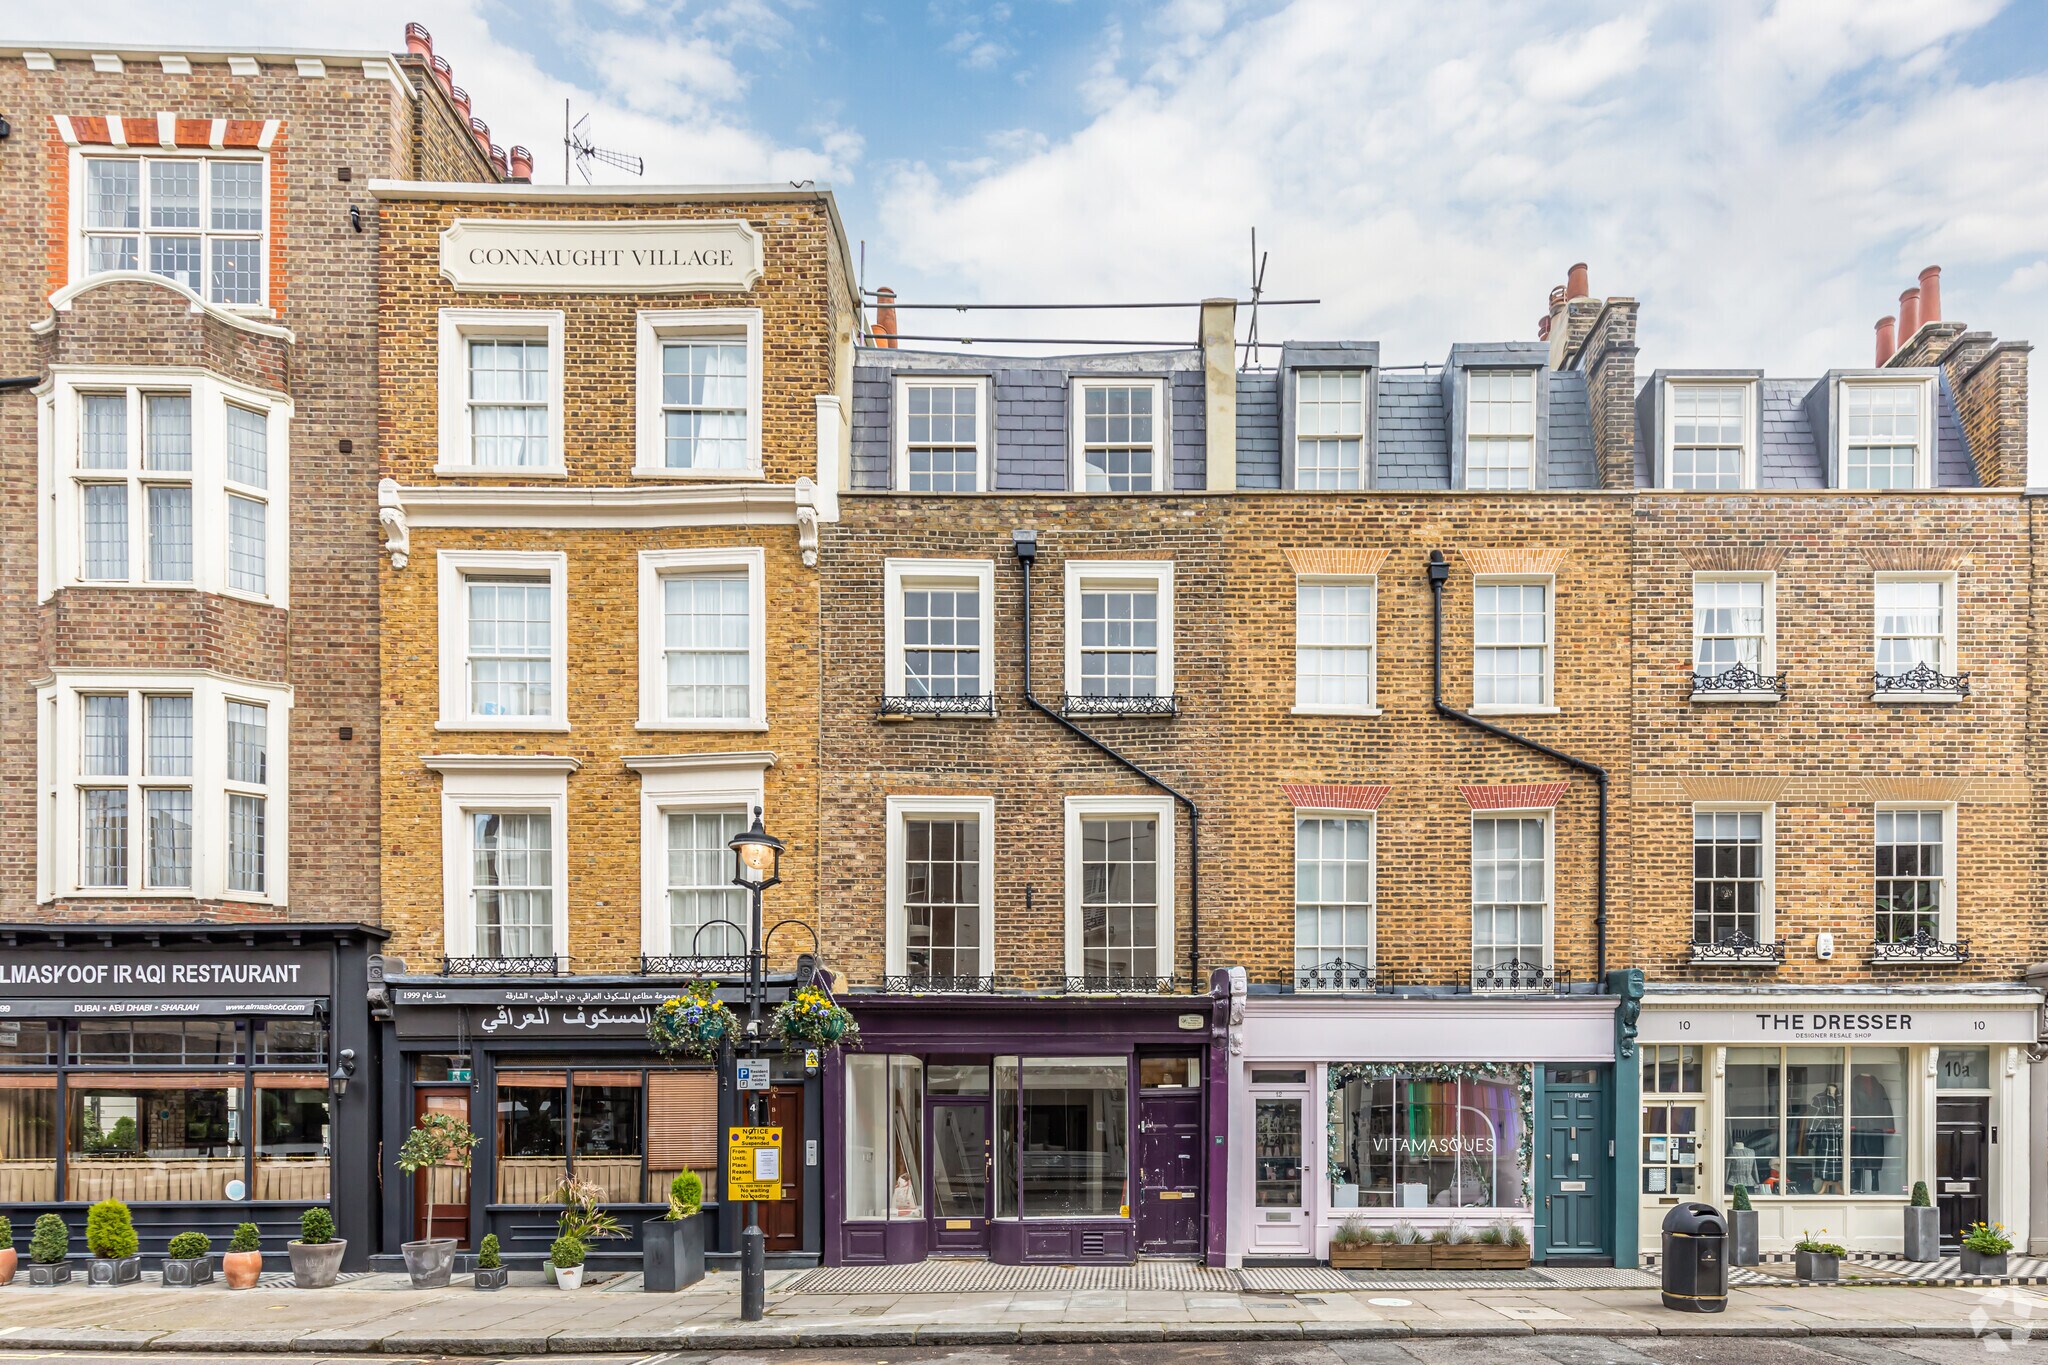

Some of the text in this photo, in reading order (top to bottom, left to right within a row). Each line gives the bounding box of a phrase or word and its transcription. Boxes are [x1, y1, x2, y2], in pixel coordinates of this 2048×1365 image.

[469, 248, 733, 266] CONNAUGHT VILLAGE
[114, 965, 165, 984] IRAQI
[172, 964, 300, 983] RESTAURANT
[422, 992, 433, 1001] عام
[505, 992, 528, 1000] الشارقة
[632, 992, 653, 1002] مطاعم
[74, 1004, 100, 1012] DUBAI
[126, 1004, 153, 1012] DHABI
[160, 1003, 200, 1011] SHARJAH
[225, 1003, 305, 1011] www.almaskoof.com
[481, 1004, 651, 1033] المسكوف العراقي
[1756, 1014, 1912, 1030] THE DRESSER
[1679, 1020, 1691, 1030] 10
[1974, 1021, 1986, 1030] 10
[1945, 1060, 1970, 1077] 10a
[750, 1104, 756, 1112] 4
[1373, 1137, 1495, 1153] VITAMASQUES
